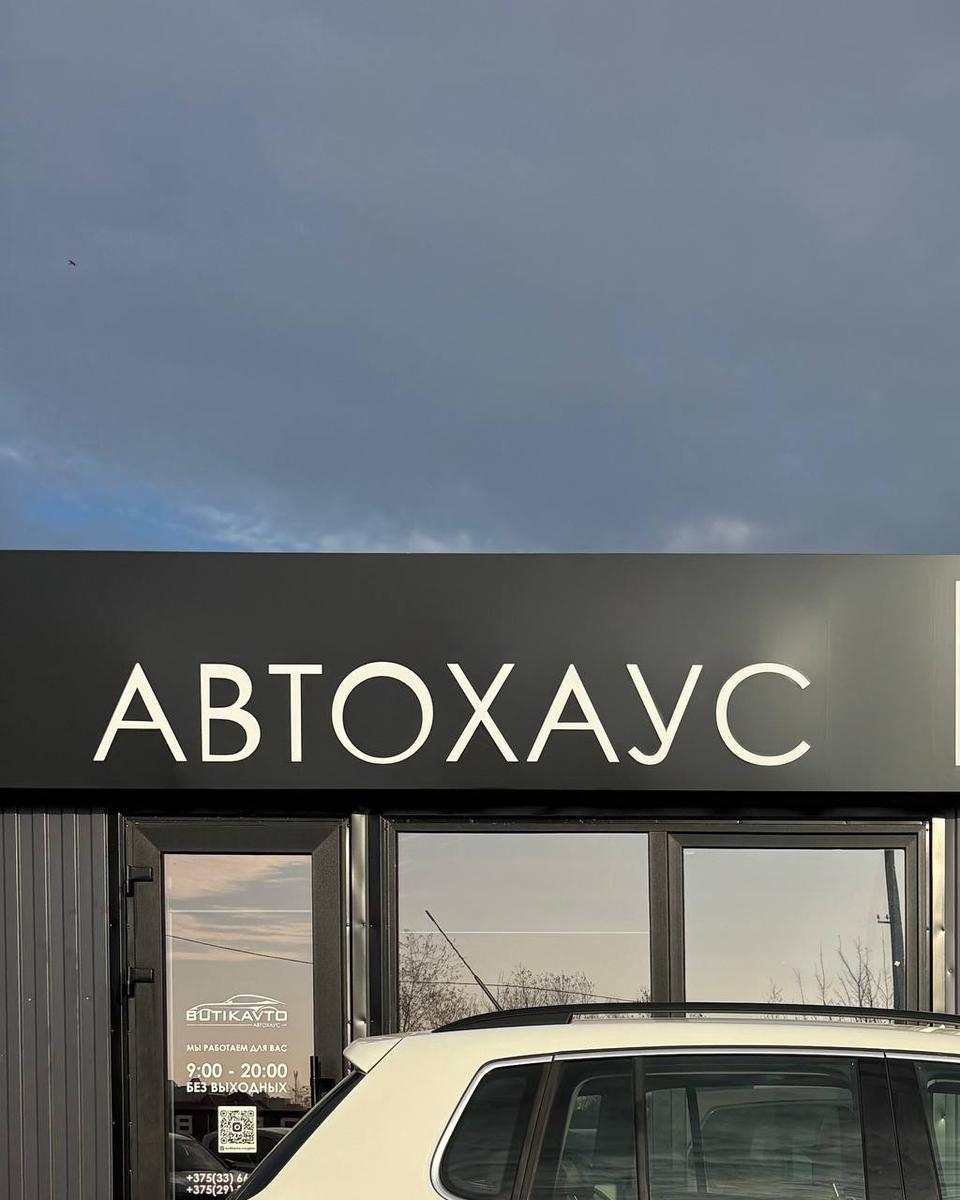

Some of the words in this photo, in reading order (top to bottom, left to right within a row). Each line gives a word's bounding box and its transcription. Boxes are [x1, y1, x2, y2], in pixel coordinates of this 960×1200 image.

[93, 662, 811, 766] АВТОХАУС
[186, 1010, 287, 1021] BUTIKAVTO
[186, 1044, 201, 1052] МЫ
[203, 1044, 248, 1052] РАБОТАЕМ
[250, 1044, 268, 1053] ДЛЯ
[270, 1044, 287, 1052] ВАС
[186, 1063, 223, 1078] 9:00
[241, 1063, 288, 1078] 20:00
[186, 1082, 207, 1093] БЕЗ
[211, 1082, 287, 1095] ВЫХОДНЫХ
[187, 1173, 233, 1184] +375(33)
